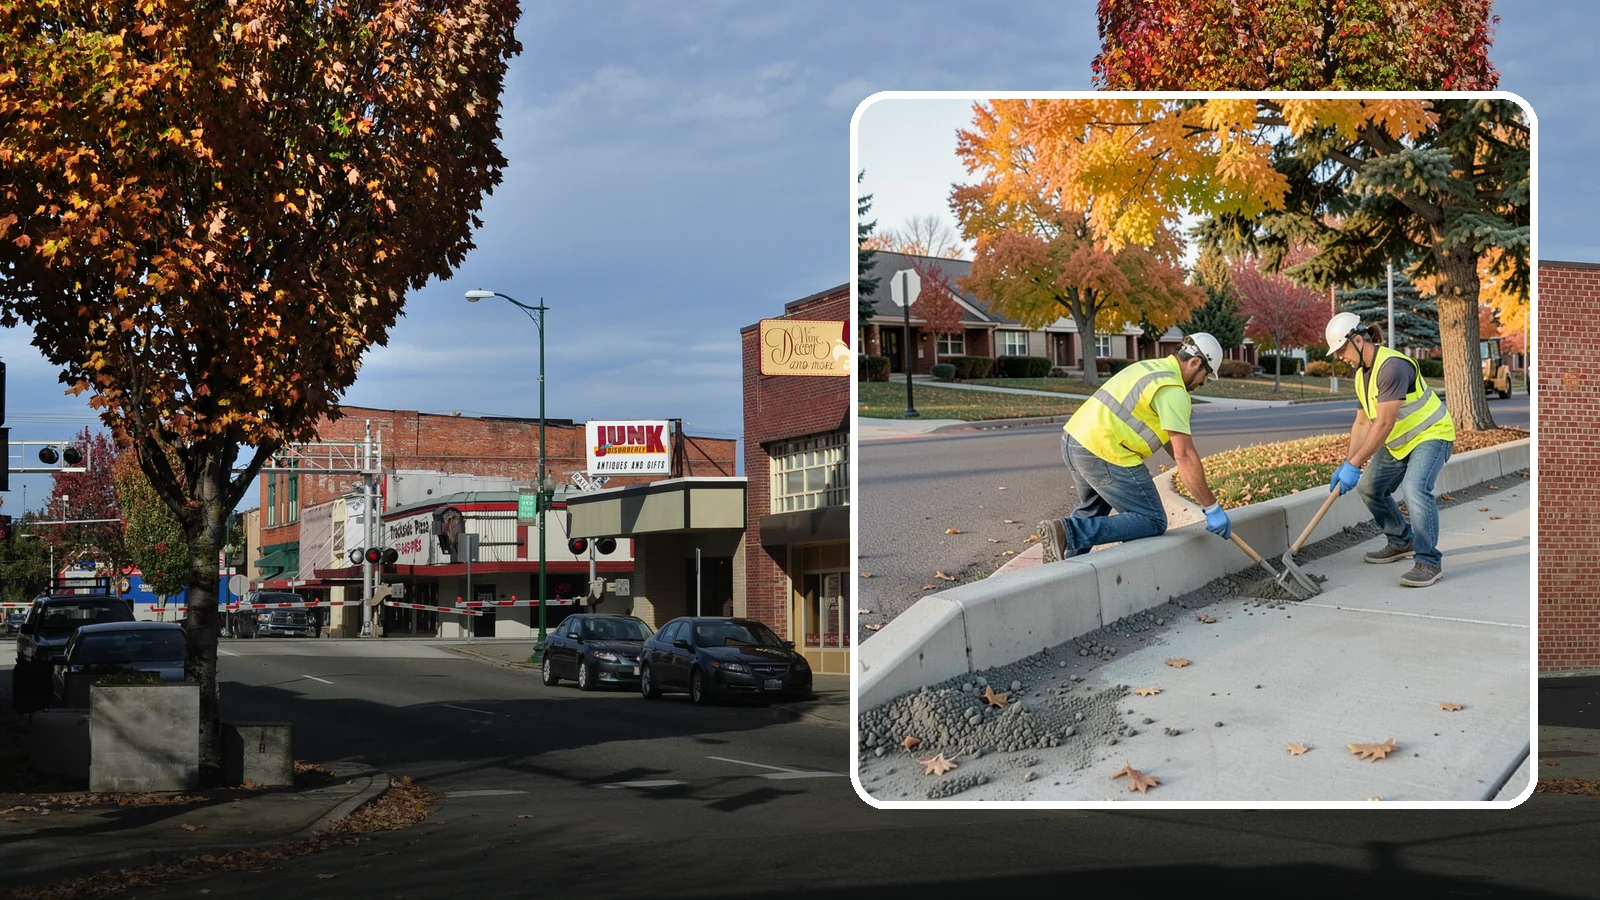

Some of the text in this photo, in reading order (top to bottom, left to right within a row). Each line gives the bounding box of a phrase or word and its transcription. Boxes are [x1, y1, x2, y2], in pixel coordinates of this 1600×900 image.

[595, 425, 665, 457] JUNK
[597, 461, 665, 470] ANTIQUES AND GIFTS
[573, 473, 588, 490] RAIL
